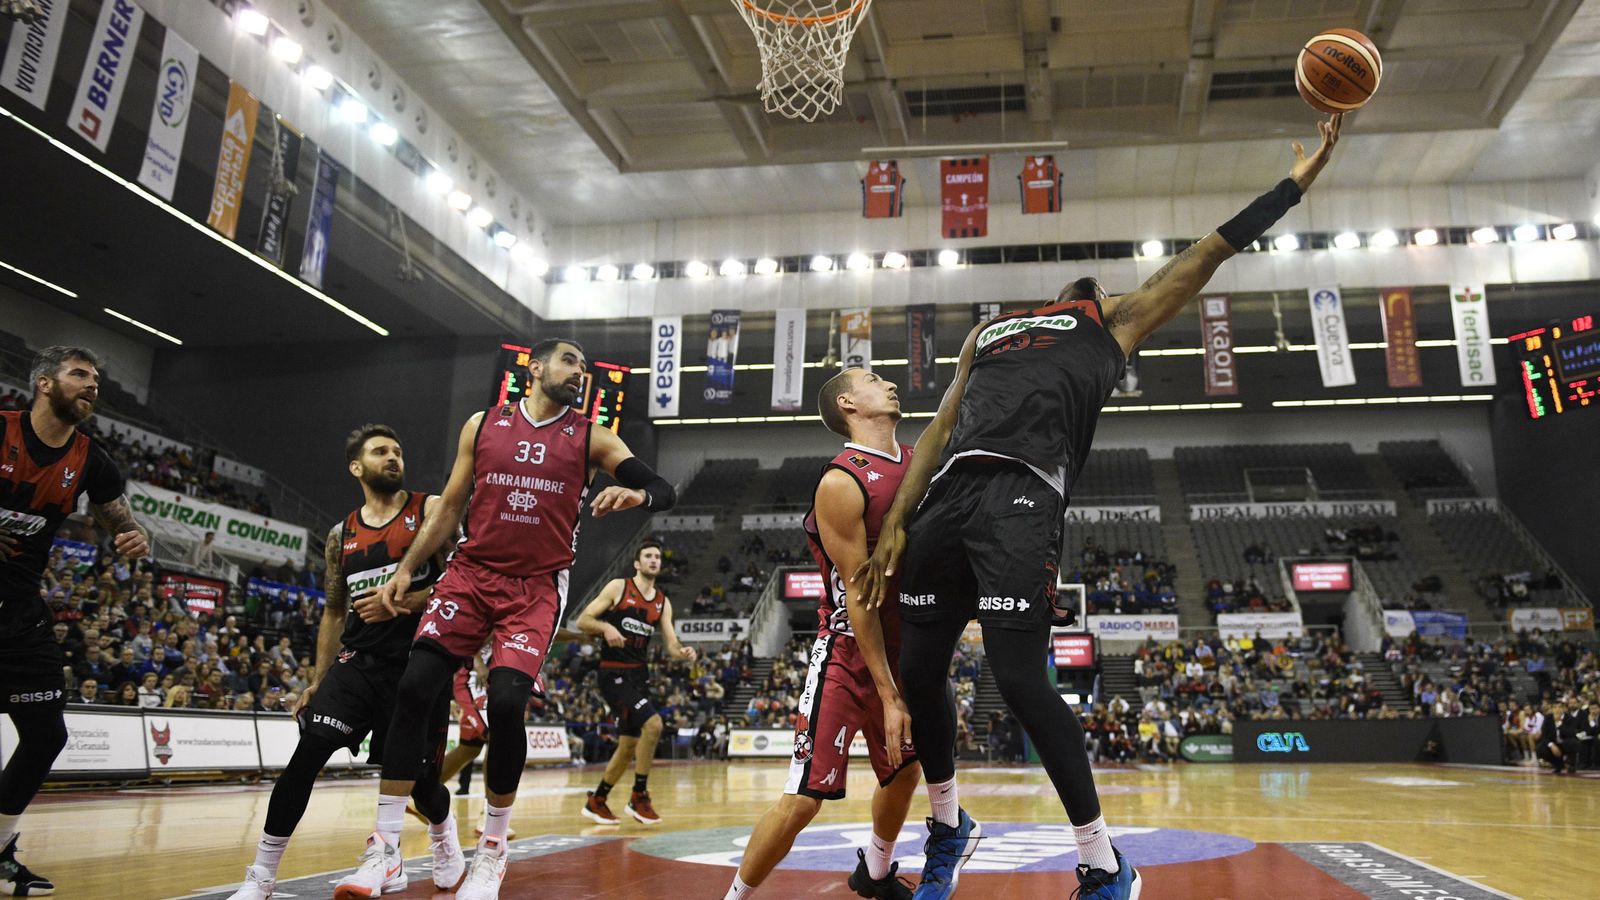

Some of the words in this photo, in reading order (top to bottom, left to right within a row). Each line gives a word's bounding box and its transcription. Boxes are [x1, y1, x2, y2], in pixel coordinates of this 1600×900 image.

[87, 0, 135, 111] BERNER
[1322, 46, 1367, 79] molten
[211, 137, 236, 217] Granada
[223, 146, 245, 209] Digital
[945, 173, 984, 184] CAMPEÓN
[977, 318, 1074, 352] OVIRAN
[1323, 314, 1344, 366] Cuerva
[1462, 309, 1484, 382] fertisac
[656, 324, 675, 389] asisa
[1211, 320, 1233, 388] kaori
[514, 440, 547, 465] 33
[486, 472, 566, 494] CARRAMIMBRE
[1012, 495, 1035, 508] vive
[1199, 505, 1257, 519] IDEAL
[1265, 504, 1325, 518] IDEAL
[1332, 503, 1394, 517] IDEAL
[1433, 501, 1496, 514] IDEAL
[130, 494, 221, 530] COVIRAN
[226, 518, 303, 551] COVIRAN
[500, 511, 540, 525] VALLADOLID
[1097, 508, 1156, 521] IDEAL
[681, 619, 724, 633] asisa
[1099, 621, 1132, 631] RADIO
[1143, 621, 1176, 631] MARCA
[10, 691, 55, 703] asisa
[76, 740, 110, 750] Granada
[834, 725, 847, 755] 4
